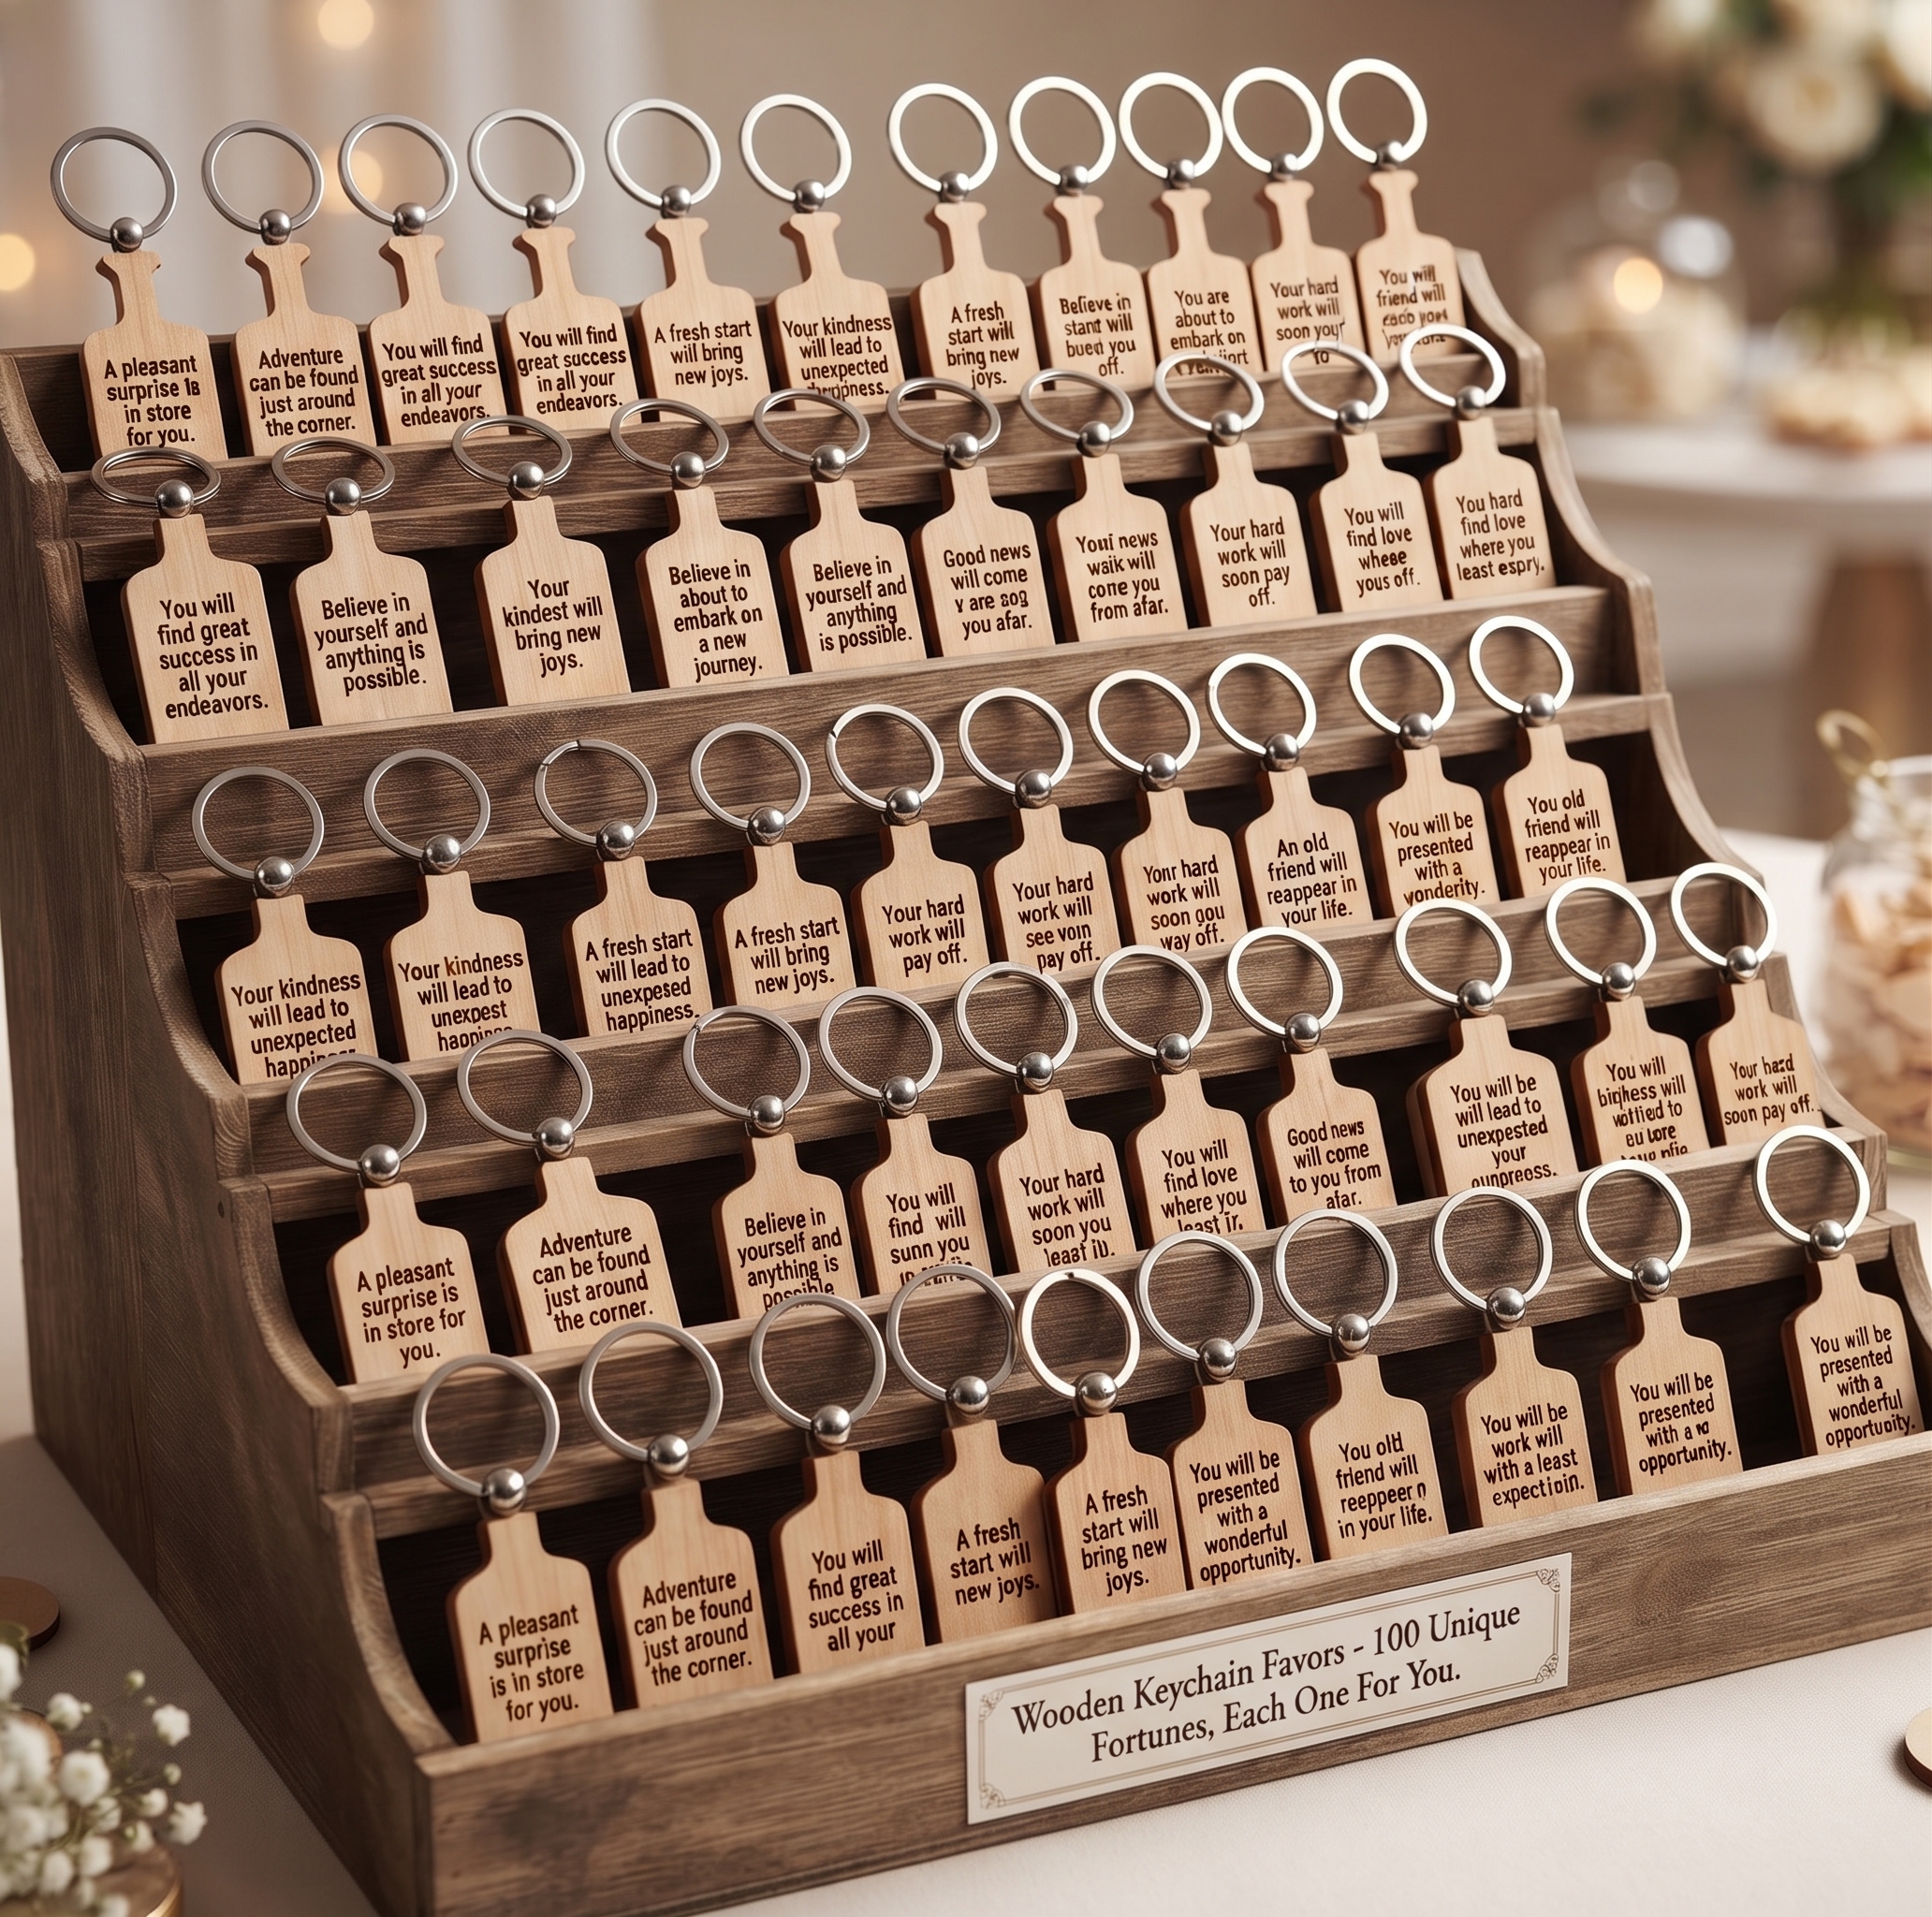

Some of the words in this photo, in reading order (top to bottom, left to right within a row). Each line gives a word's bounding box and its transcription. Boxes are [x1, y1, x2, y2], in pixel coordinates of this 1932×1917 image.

[951, 306, 963, 324] A
[964, 300, 1004, 323] fresh
[1174, 290, 1204, 308] You
[1207, 291, 1230, 305] are
[654, 326, 666, 344] A
[668, 321, 710, 343] fresh
[714, 320, 753, 339] start
[947, 326, 985, 346] start
[987, 320, 1016, 342] will
[1175, 308, 1218, 329] about
[1219, 308, 1236, 325] to
[669, 342, 698, 364] will
[701, 342, 744, 365] bring
[1170, 328, 1226, 354] embark
[1227, 331, 1246, 344] on
[258, 347, 344, 370] Adventure
[945, 347, 988, 371] bring
[988, 347, 1020, 363] new
[249, 375, 282, 392] can
[284, 370, 306, 389] be
[309, 364, 359, 388] found
[674, 370, 707, 386] new
[710, 365, 749, 388] joys.
[971, 369, 1007, 391] joys.
[259, 395, 294, 420] just
[297, 387, 356, 412] around
[265, 417, 294, 438] the
[297, 416, 356, 439] corner.
[1209, 523, 1246, 542] Your
[1249, 516, 1285, 538] hard
[1217, 541, 1258, 566] work
[1259, 538, 1286, 560] will
[667, 563, 732, 586] Believe
[733, 558, 752, 578] in
[1221, 569, 1261, 589] soon
[1265, 563, 1291, 590] pay
[526, 578, 570, 600] Your
[680, 585, 728, 608] about
[730, 584, 749, 602] to
[1248, 586, 1276, 608] off.
[158, 599, 198, 620] You
[200, 591, 236, 616] will
[502, 601, 570, 628] kindest
[572, 594, 604, 619] will
[673, 604, 739, 633] embark
[740, 607, 764, 624] on
[156, 621, 196, 646] find
[200, 617, 251, 647] great
[514, 627, 563, 651] bring
[565, 624, 601, 644] new
[698, 637, 710, 653] a
[712, 633, 747, 651] new
[159, 647, 236, 670] success
[239, 641, 258, 662] in
[539, 652, 584, 679] joys.
[693, 655, 763, 684] journey.
[179, 669, 201, 693] all
[204, 669, 248, 695] your
[165, 694, 269, 720] endeavors.
[1527, 796, 1559, 815] You
[1561, 788, 1586, 811] old
[1524, 812, 1571, 839] friend
[1573, 809, 1601, 830] will
[1277, 839, 1299, 858] An
[1303, 830, 1330, 855] old
[1525, 838, 1592, 863] reappear
[1594, 832, 1611, 851] in
[1266, 855, 1316, 882] friend
[1319, 851, 1348, 873] will
[1538, 862, 1573, 886] your
[1575, 854, 1606, 876] life.
[1266, 880, 1338, 907] reappear
[1339, 874, 1358, 893] in
[881, 904, 923, 925] Your
[925, 893, 965, 919] hard
[1281, 907, 1317, 929] your
[1320, 898, 1354, 920] life.
[887, 923, 932, 949] work
[934, 917, 965, 942] will
[902, 952, 932, 978] pay
[937, 942, 968, 966] off.
[1287, 1120, 1328, 1147] Good
[1330, 1120, 1365, 1139] news
[1293, 1145, 1323, 1170] will
[1325, 1143, 1370, 1164] come
[1288, 1176, 1308, 1194] to
[1310, 1172, 1341, 1196] you
[1343, 1163, 1383, 1185] from
[539, 1226, 633, 1259] Adventure
[357, 1270, 373, 1293] A
[375, 1257, 456, 1296] pleasant
[532, 1265, 566, 1285] can
[569, 1256, 594, 1279] be
[596, 1243, 651, 1273] found
[360, 1288, 438, 1320] surprise
[440, 1281, 460, 1303] is
[543, 1283, 581, 1317] just
[585, 1267, 650, 1301] around
[362, 1322, 382, 1343] in
[387, 1316, 435, 1340] store
[438, 1308, 466, 1330] for
[553, 1309, 585, 1334] the
[589, 1299, 653, 1326] corner.
[1809, 1336, 1840, 1354] You
[1844, 1325, 1870, 1349] will
[1872, 1324, 1893, 1343] be
[399, 1342, 441, 1369] you.
[1819, 1343, 1894, 1383] presented
[1836, 1374, 1871, 1398] with
[1873, 1373, 1885, 1391] a
[1827, 1387, 1904, 1423] wonderful
[1189, 1462, 1222, 1485] You
[1224, 1451, 1255, 1477] will
[1258, 1449, 1281, 1471] be
[1196, 1471, 1281, 1515] presented
[1216, 1502, 1254, 1528] with
[1258, 1505, 1268, 1521] a
[1204, 1518, 1289, 1556] wonderful
[1199, 1545, 1302, 1587] opportunity.
[642, 1572, 737, 1609] Adventure
[479, 1621, 493, 1646] A
[498, 1603, 579, 1647] pleasant
[634, 1614, 667, 1637] can
[671, 1604, 695, 1628] be
[698, 1588, 754, 1622] found
[493, 1636, 572, 1670] surprise
[642, 1634, 680, 1668] just
[684, 1617, 749, 1653] around
[489, 1676, 507, 1699] is
[510, 1672, 531, 1693] in
[535, 1663, 585, 1689] store
[651, 1661, 682, 1687] the
[687, 1650, 753, 1678] corner.
[1010, 1689, 1125, 1734] Wooden
[1134, 1660, 1254, 1712] Keychain
[1261, 1645, 1345, 1680] Favors
[1373, 1618, 1420, 1656] 100
[1427, 1606, 1520, 1643] Unique
[505, 1699, 534, 1722] for
[538, 1693, 579, 1723] you.
[1090, 1719, 1215, 1763] Fortunes,
[1222, 1691, 1287, 1734] Each
[1295, 1685, 1351, 1716] One
[1356, 1671, 1400, 1703] For
[1406, 1659, 1461, 1690] You.
